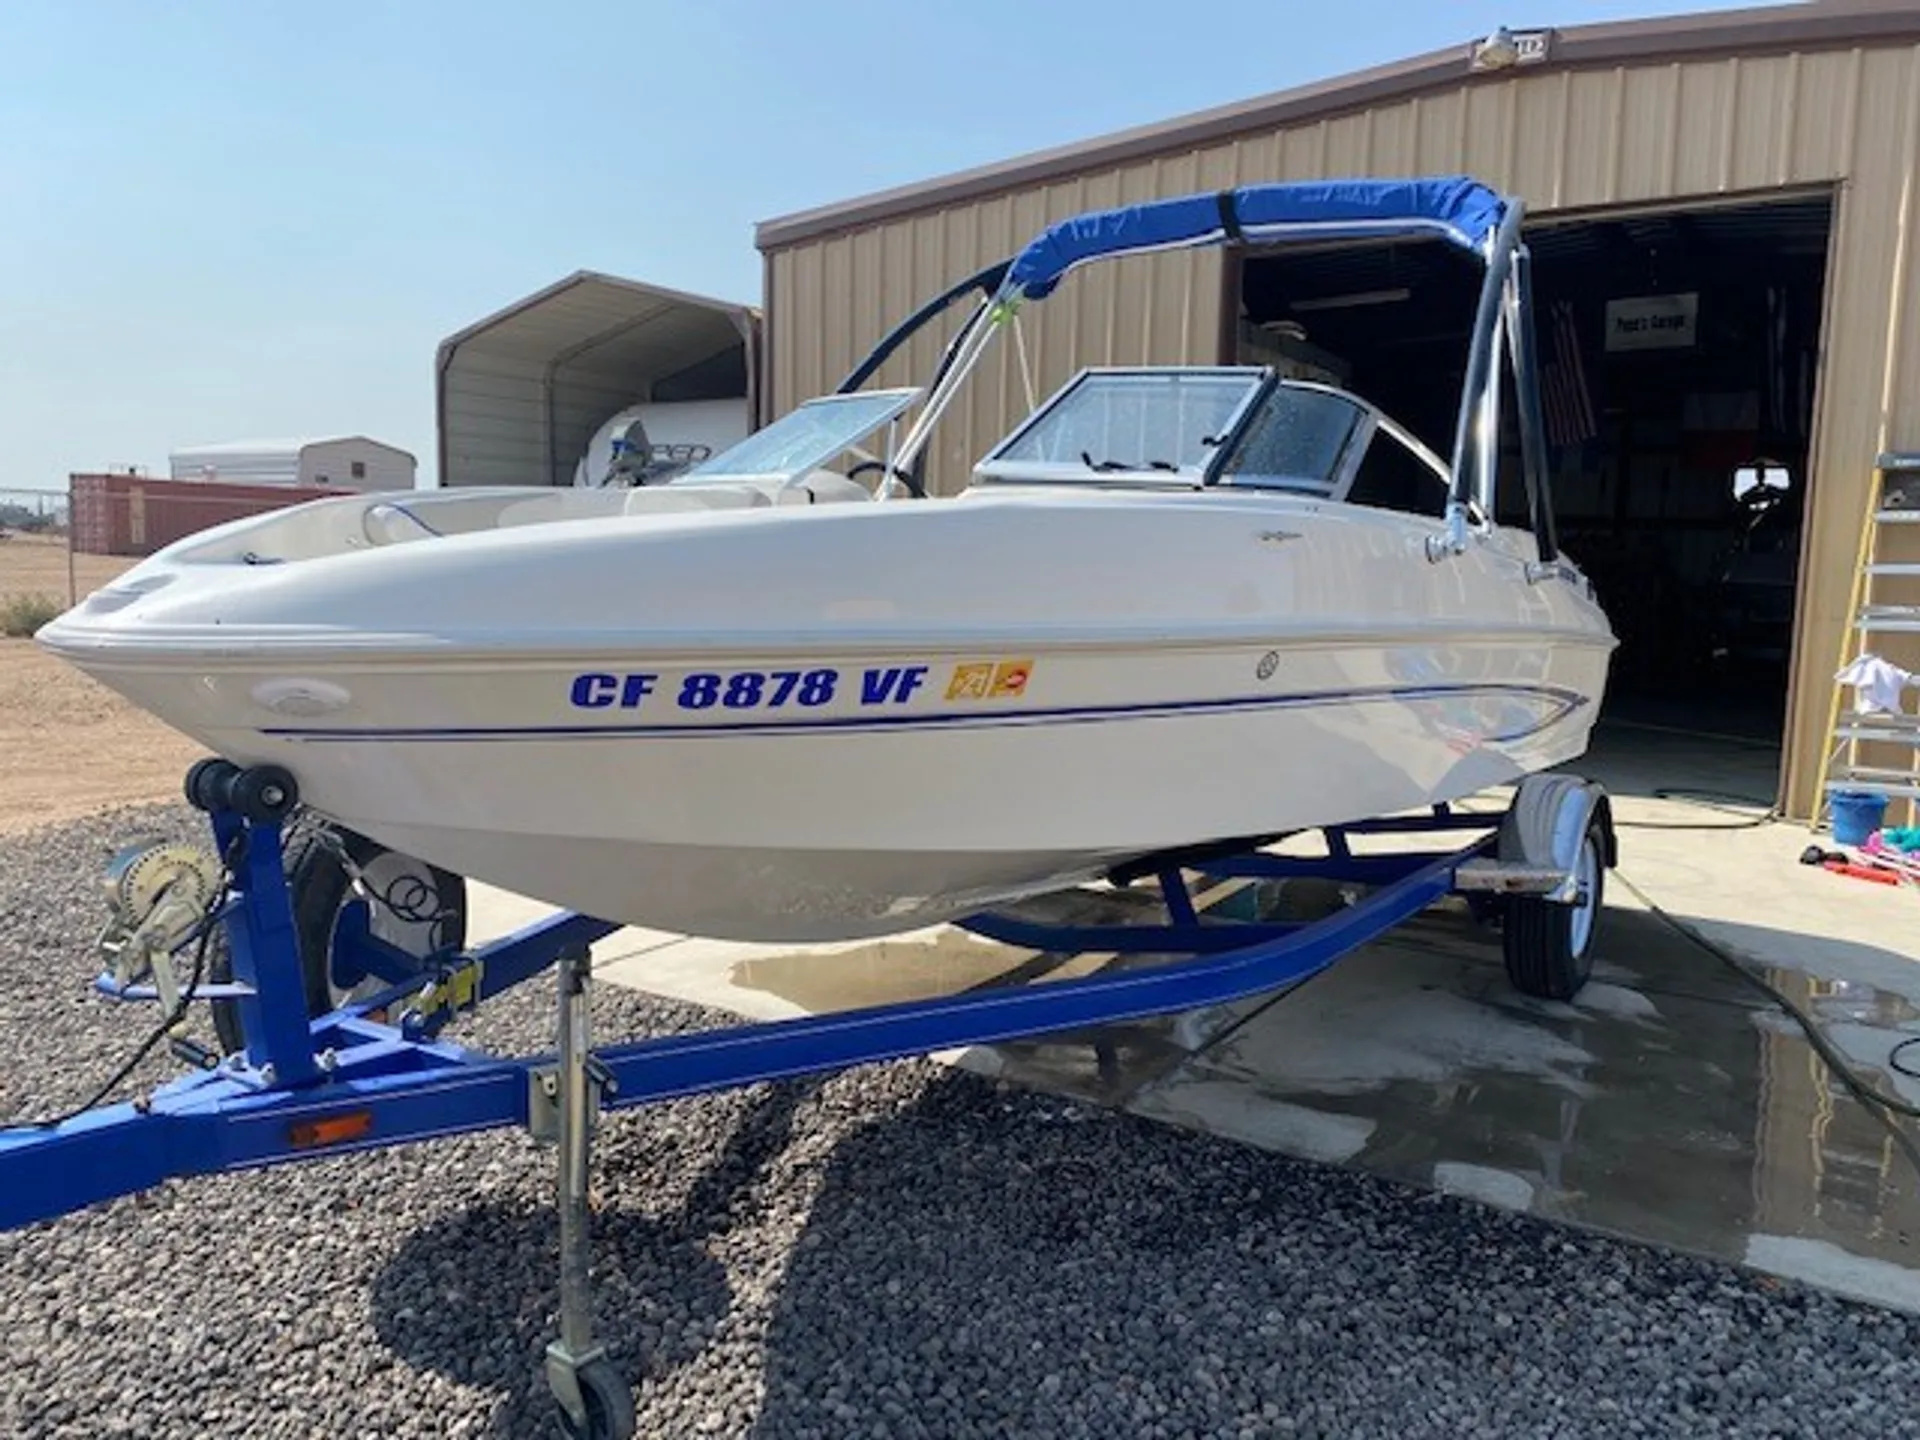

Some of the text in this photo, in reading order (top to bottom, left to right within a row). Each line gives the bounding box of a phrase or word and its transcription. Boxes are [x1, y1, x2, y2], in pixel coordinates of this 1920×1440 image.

[570, 666, 928, 709] CF 8878 VF
